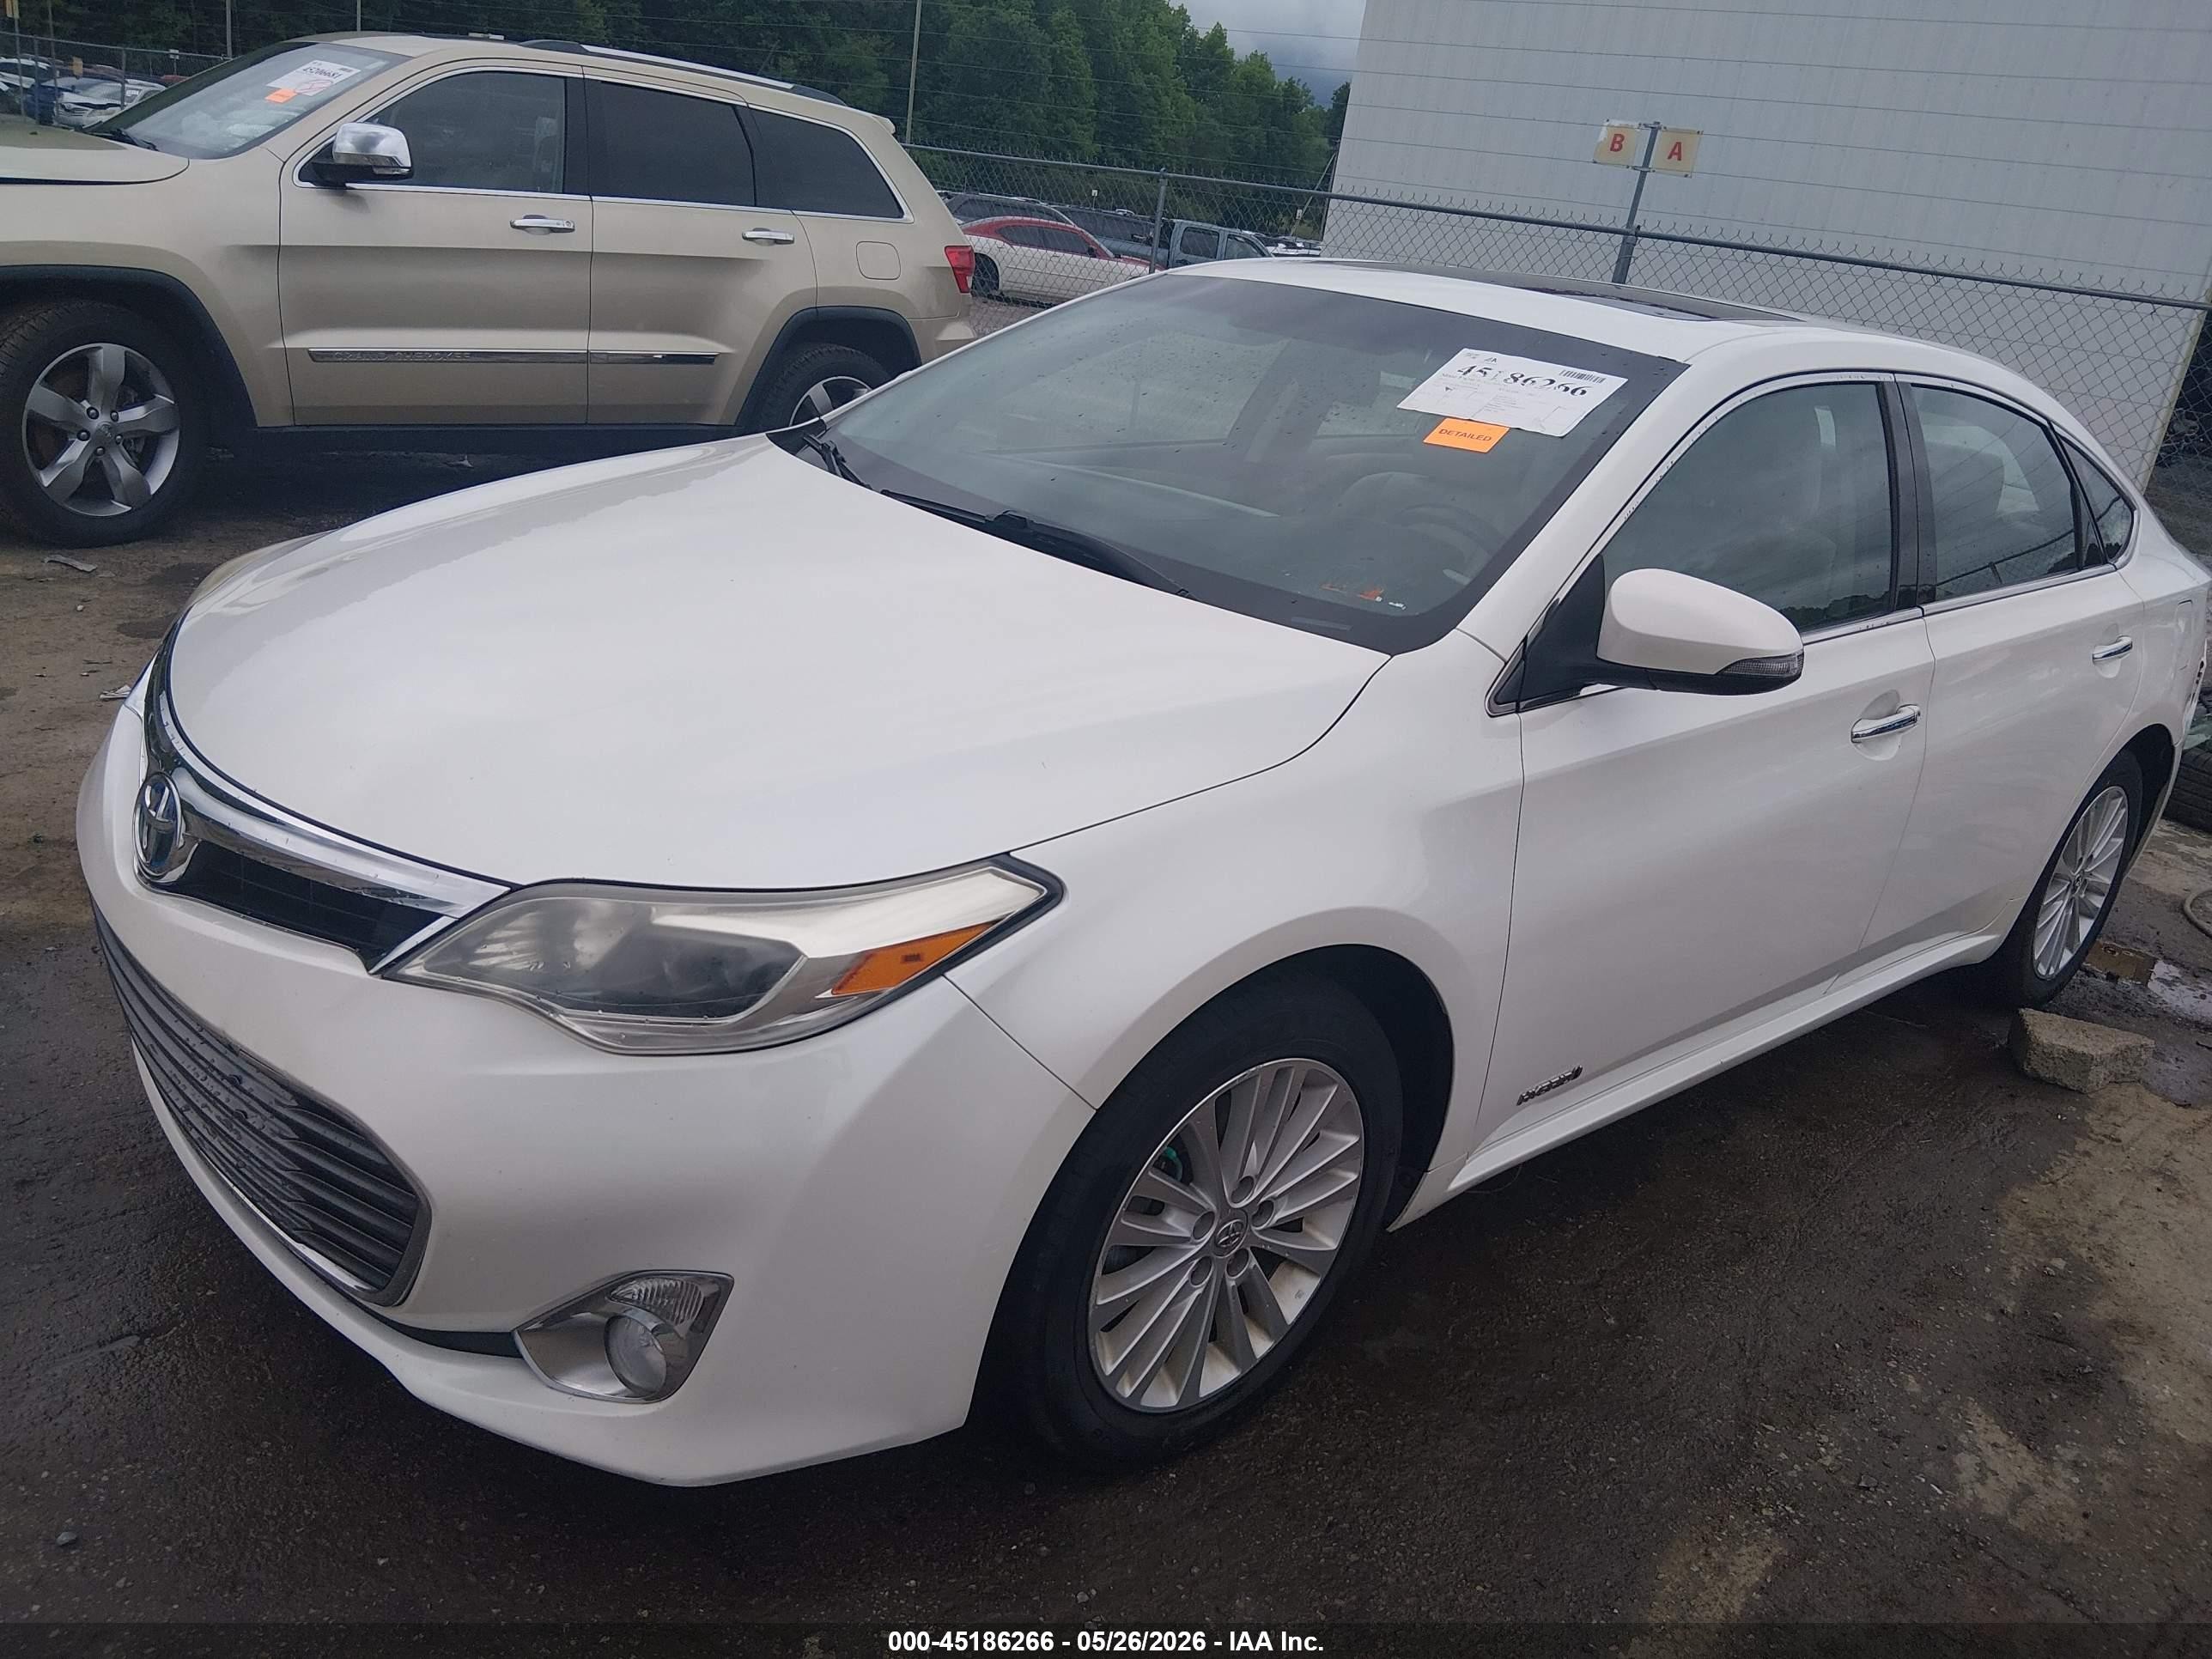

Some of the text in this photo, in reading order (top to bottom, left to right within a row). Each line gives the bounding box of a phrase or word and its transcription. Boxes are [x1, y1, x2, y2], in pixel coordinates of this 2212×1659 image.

[1610, 133, 1625, 152] B
[1668, 142, 1682, 161] A
[1438, 428, 1492, 442] DETAILED
